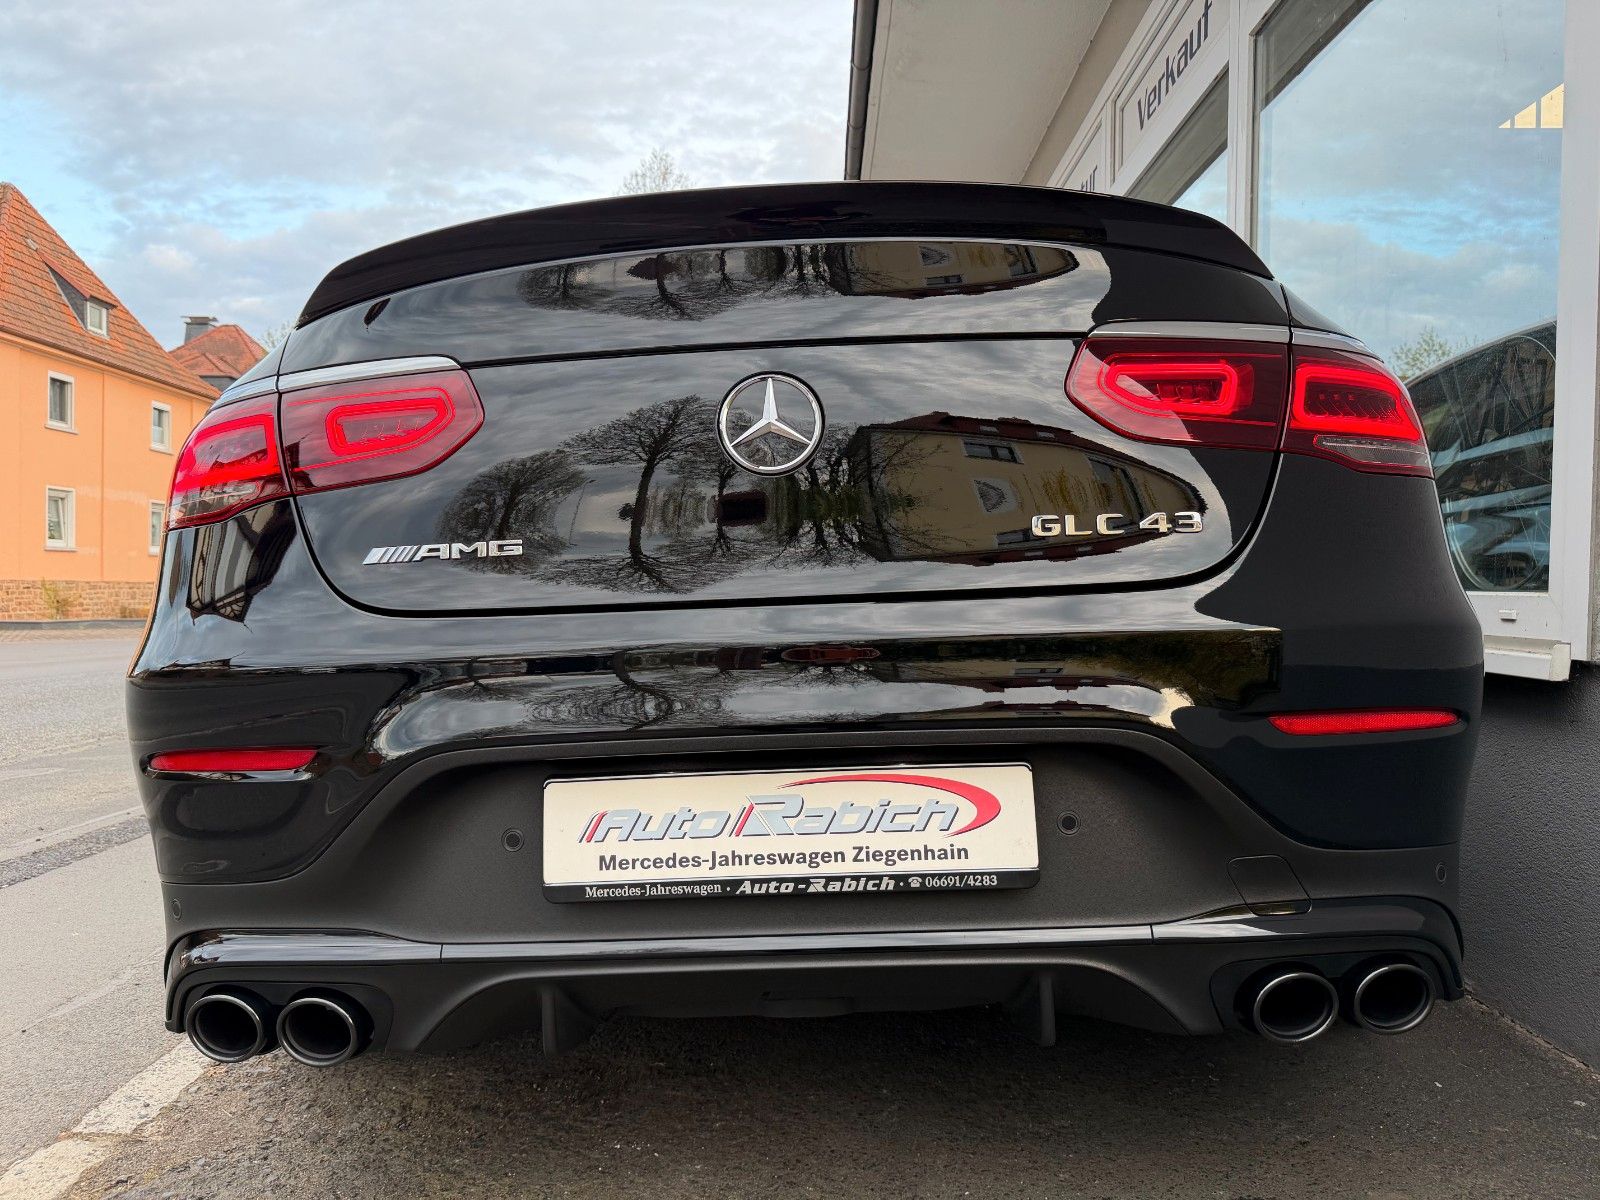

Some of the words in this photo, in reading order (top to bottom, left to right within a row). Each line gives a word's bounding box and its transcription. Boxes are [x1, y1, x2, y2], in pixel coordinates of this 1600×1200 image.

[1137, 0, 1212, 130] Verkauf
[1031, 513, 1125, 537] GLC
[1139, 511, 1203, 533] 43
[412, 539, 523, 562] AMG
[593, 806, 731, 843] Auto
[741, 793, 959, 837] Rabich
[599, 849, 846, 871] Mercedes-Jahreswagen
[852, 843, 969, 866] Ziegenhain
[585, 884, 722, 898] Mercedes-Jahreswagen
[925, 875, 998, 888] 06691/4283
